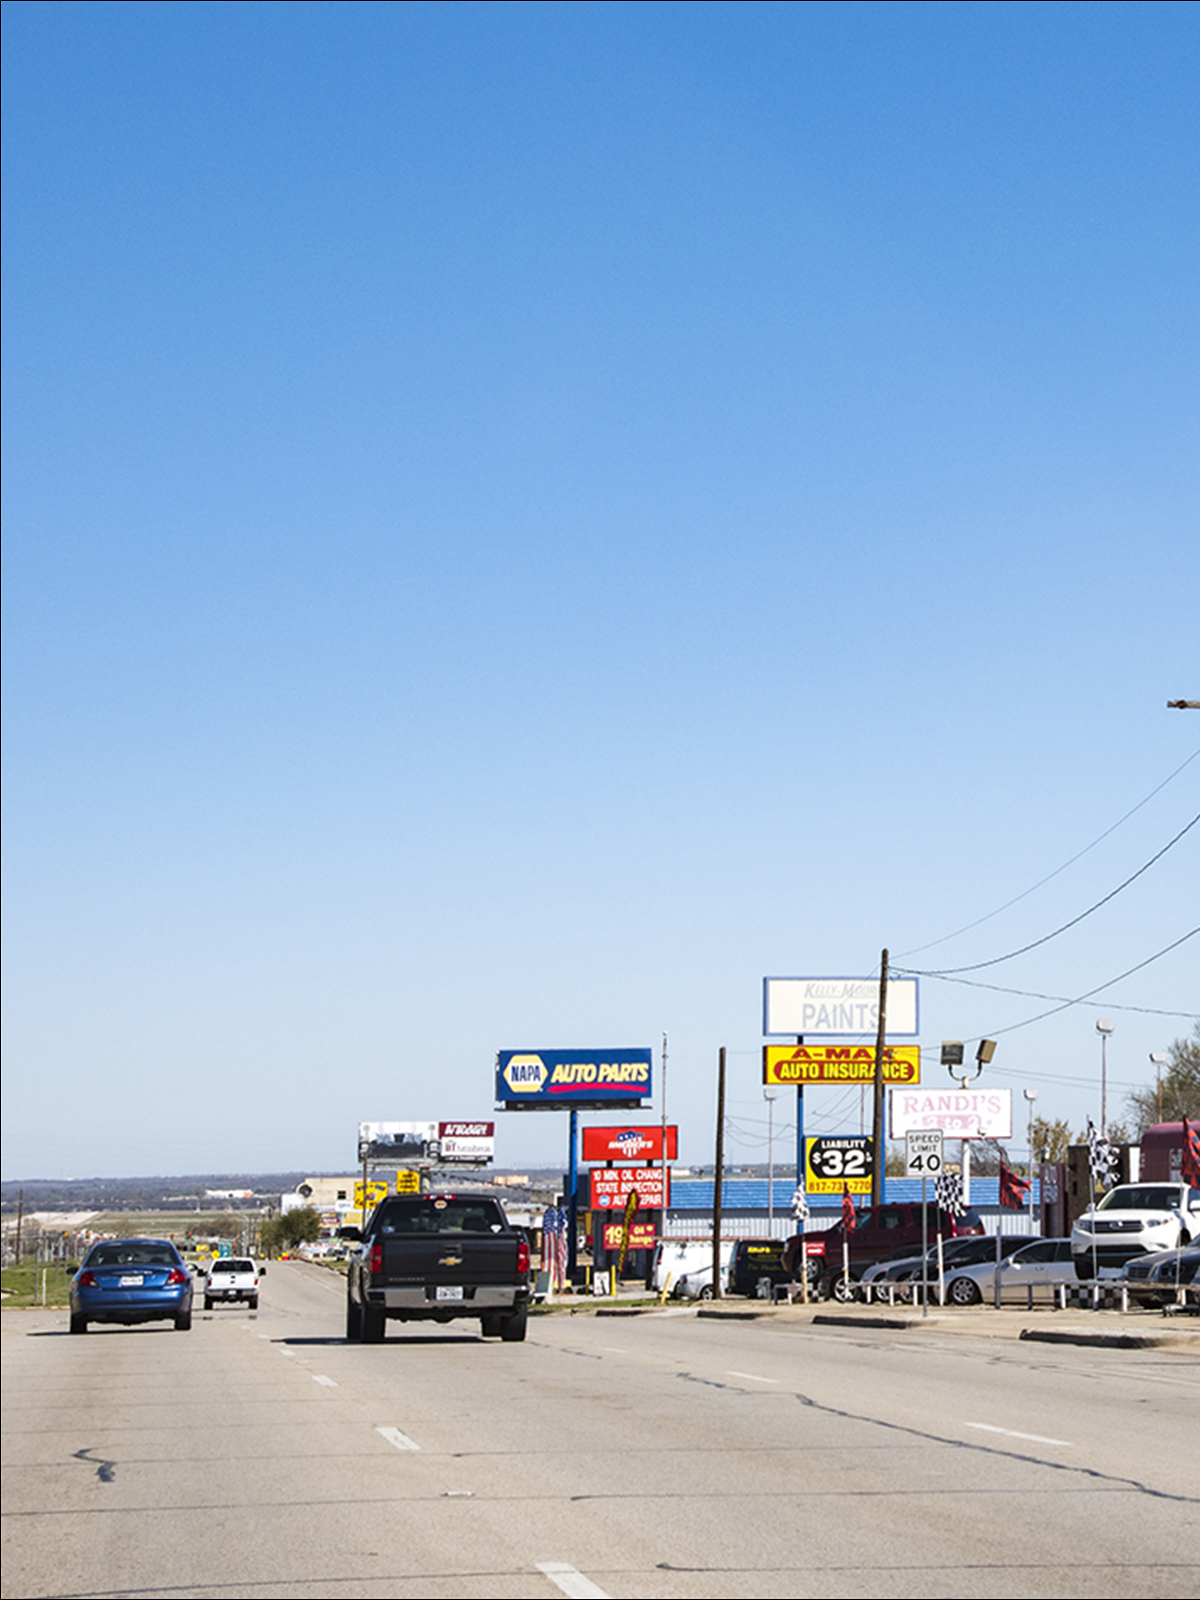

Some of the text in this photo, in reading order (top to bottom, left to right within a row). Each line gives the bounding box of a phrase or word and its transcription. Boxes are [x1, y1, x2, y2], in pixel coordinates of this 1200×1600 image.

[804, 984, 877, 999] KELLY-MOOR
[511, 1065, 541, 1082] NAPA
[550, 1063, 649, 1083] AUTO PARTS
[780, 1063, 820, 1078] AUTO
[903, 1095, 1001, 1115] RANDI'S
[821, 1140, 866, 1148] LIABILITY
[909, 1135, 940, 1144] SPEED
[912, 1145, 937, 1153] LIMIT
[909, 1154, 941, 1171] 40
[621, 1170, 634, 1180] OIL
[636, 1169, 662, 1180] CHANG
[596, 1182, 618, 1193] STATE
[808, 1181, 871, 1191] 817-73-770
[612, 1194, 662, 1206] AUT EPAIR
